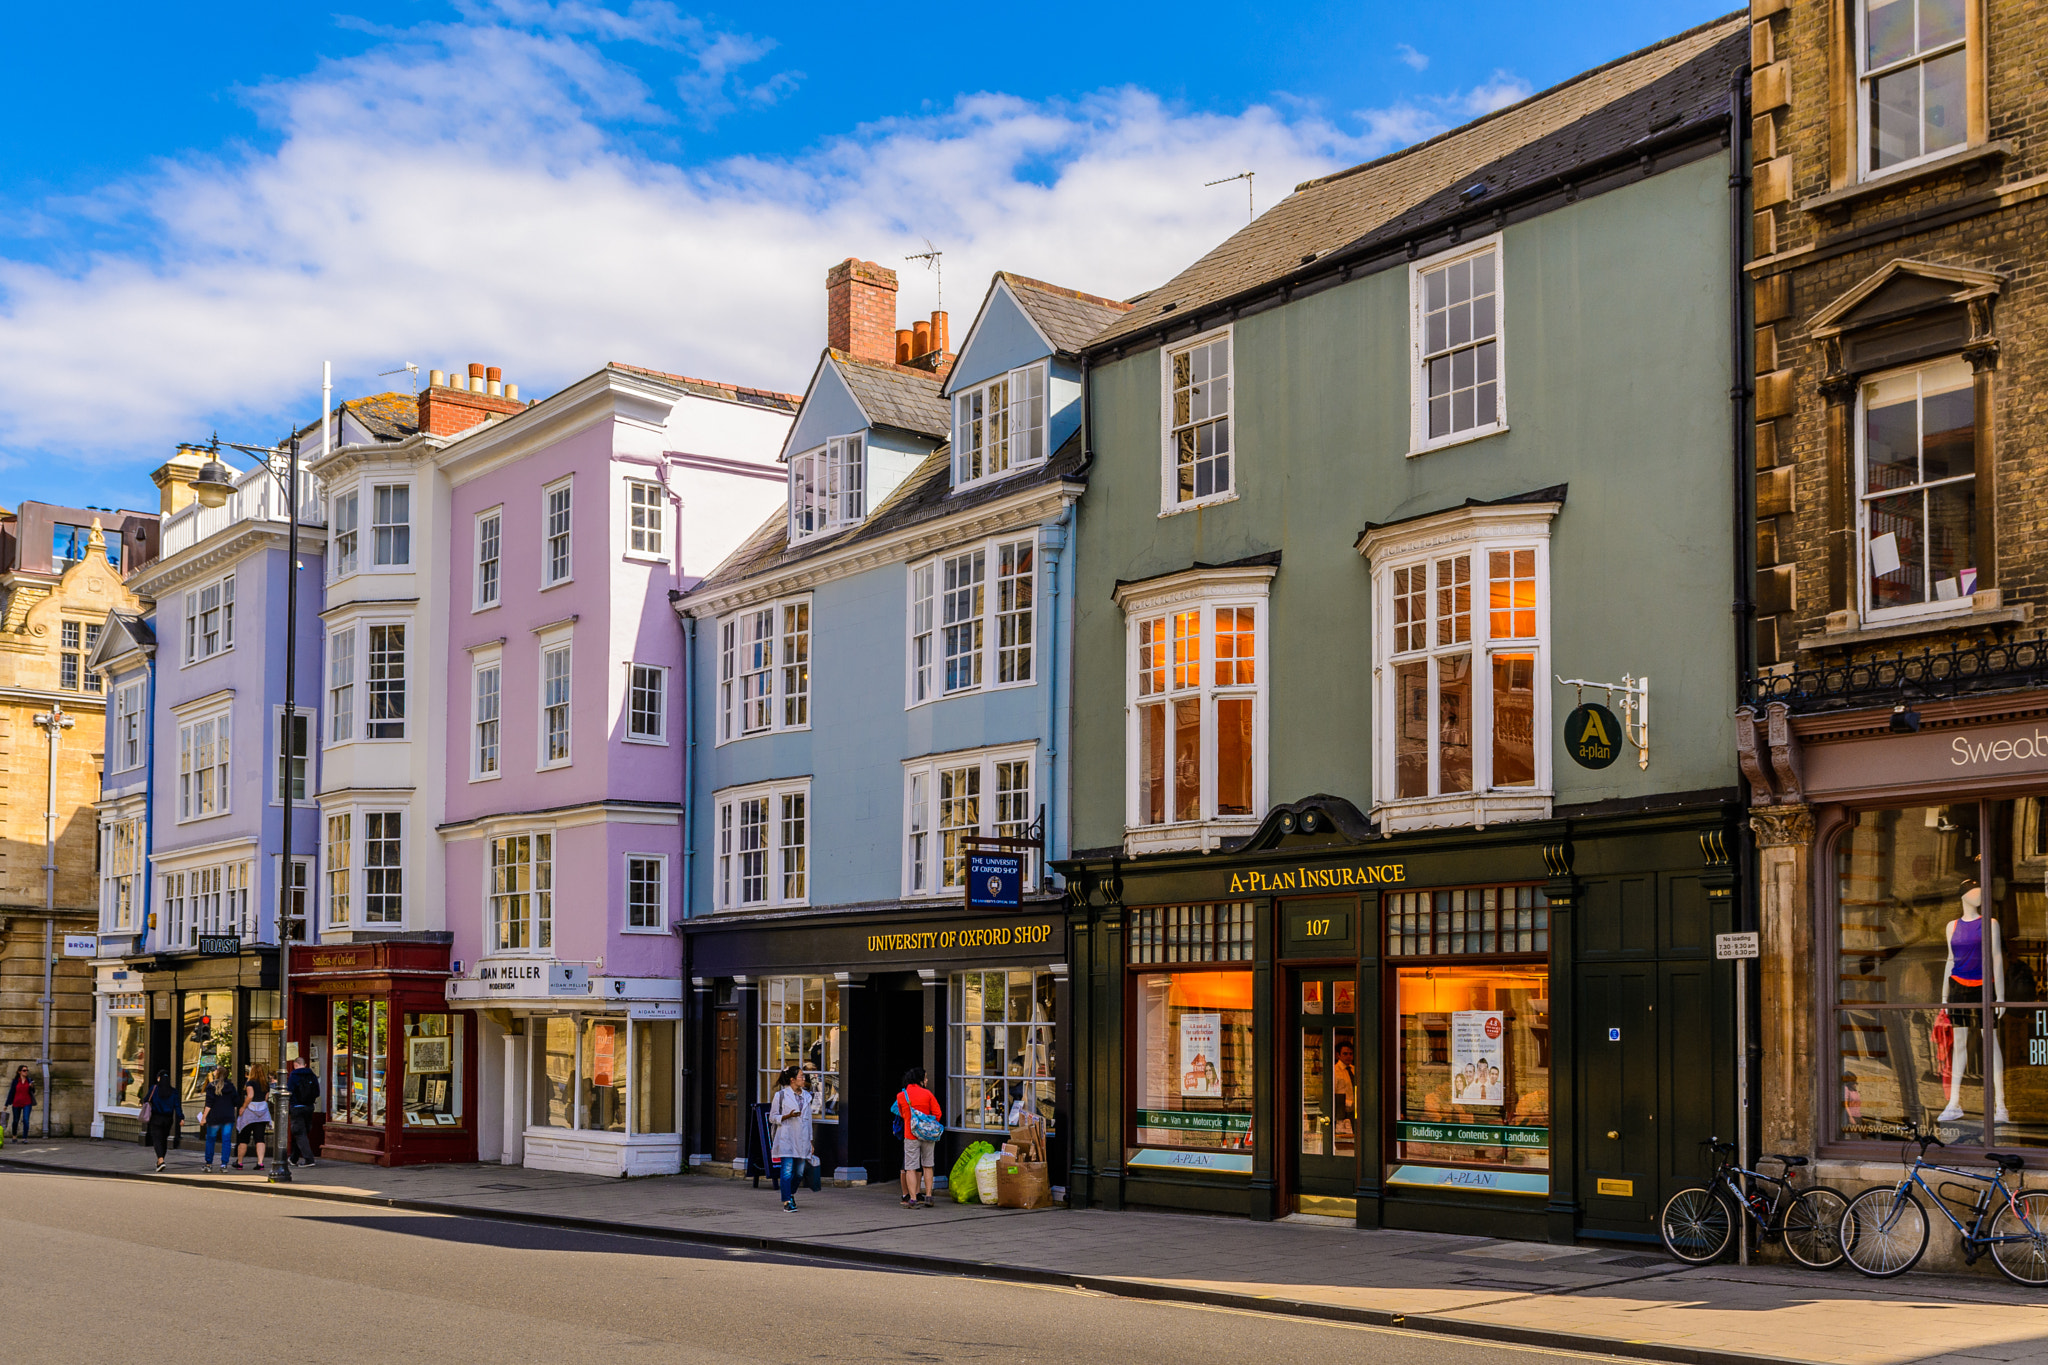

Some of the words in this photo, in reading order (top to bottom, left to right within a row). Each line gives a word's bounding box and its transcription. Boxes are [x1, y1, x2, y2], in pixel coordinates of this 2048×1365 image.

[1579, 743, 1610, 760] a-plan
[1951, 728, 2048, 766] Sweat
[971, 857, 983, 865] THE
[985, 858, 1018, 866] UNIVERSITY
[980, 866, 1002, 874] OXFORD
[1306, 919, 1330, 936] 107
[868, 932, 938, 951] UNIVERSITY
[940, 930, 956, 948] OF
[959, 928, 1011, 947] OXFORD
[1014, 924, 1051, 943] SHOP
[201, 938, 239, 953] TOAST
[338, 952, 356, 966] Oxford
[501, 966, 541, 979] MELLER
[1150, 1115, 1159, 1123] Car
[1170, 1116, 1181, 1124] Van
[1193, 1117, 1222, 1128] Motorcycle
[1412, 1127, 1443, 1140] Buildings
[1458, 1129, 1489, 1140] Contents
[1504, 1132, 1540, 1143] Landlords
[1173, 1154, 1210, 1165] A-PLAN
[1444, 1172, 1493, 1185] A-PLAN
